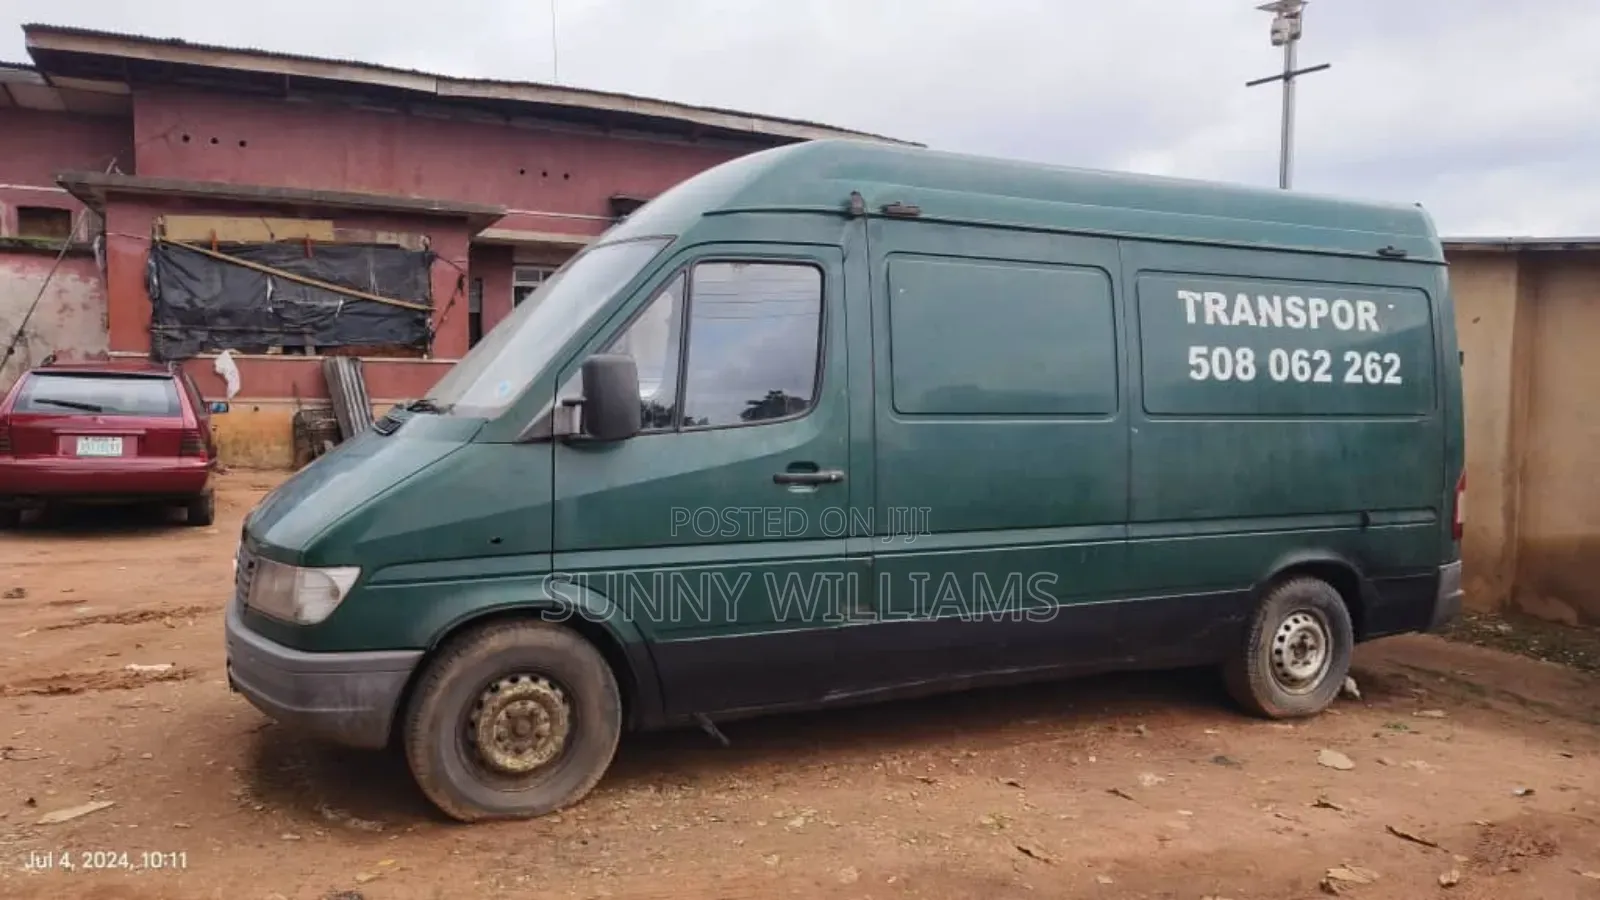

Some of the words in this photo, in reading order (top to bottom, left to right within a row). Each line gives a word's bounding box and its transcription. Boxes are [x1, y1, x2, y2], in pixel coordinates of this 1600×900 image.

[1177, 290, 1380, 332] TRANSPOR
[1188, 345, 1256, 381] 508
[1268, 348, 1333, 382] 062
[1343, 351, 1402, 384] 262
